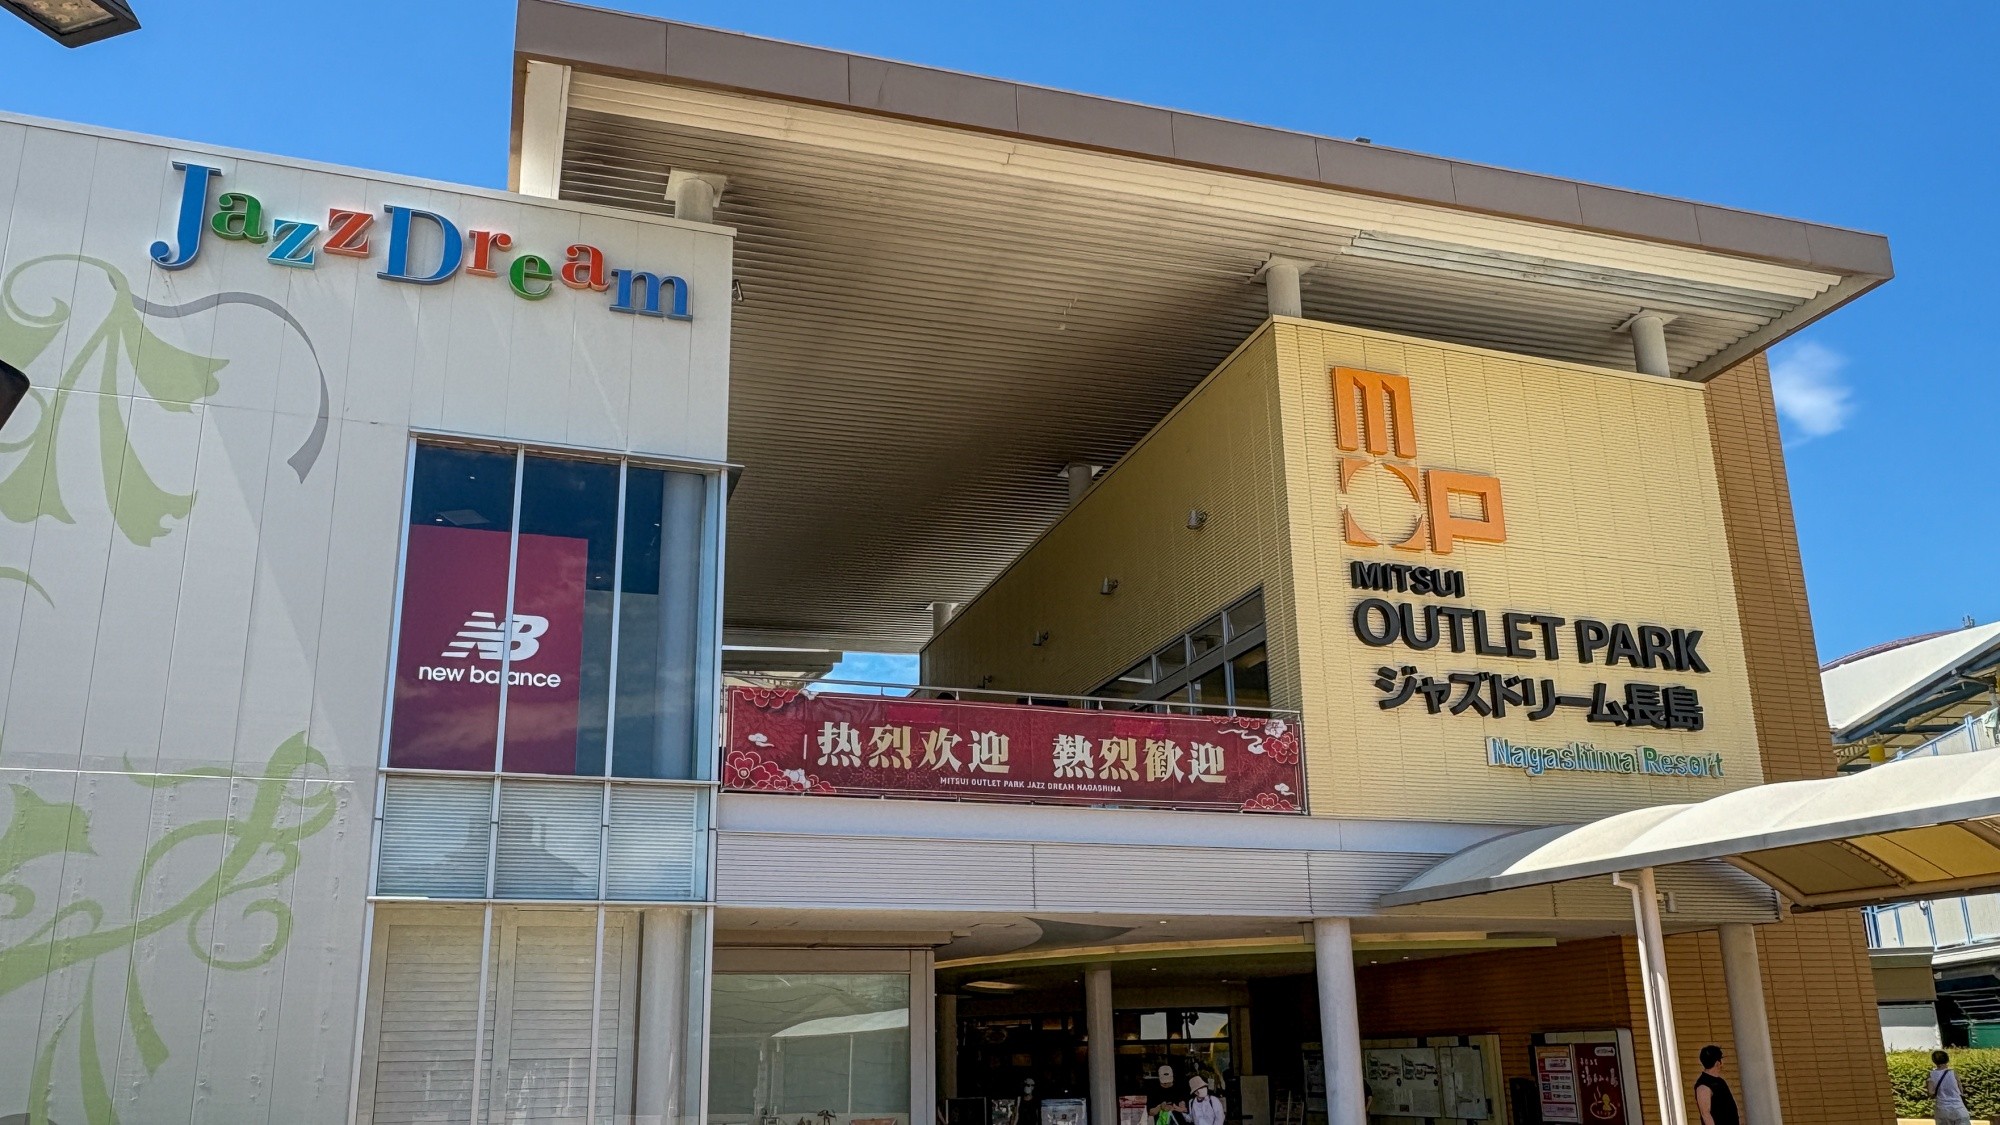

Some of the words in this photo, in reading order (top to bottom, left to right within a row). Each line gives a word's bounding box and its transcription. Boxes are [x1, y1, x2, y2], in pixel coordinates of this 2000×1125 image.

[1350, 560, 1466, 599] MITSUI
[1352, 598, 1566, 661] OUTLET
[1574, 619, 1711, 674] PARK
[418, 665, 465, 683] new
[469, 664, 562, 689] baance
[1374, 665, 1704, 732] ジャズドリーム長島
[817, 720, 1010, 774] 热烈欢迎
[1487, 736, 1638, 777] Nagashima
[1638, 744, 1725, 779] Resort
[940, 776, 969, 786] MITSUI
[971, 778, 1001, 787] OUTLET
[1003, 779, 1025, 788] PARK
[1026, 780, 1046, 790] JAZZ
[1047, 782, 1075, 791] DREAM
[1076, 784, 1122, 793] NAGASHIMA
